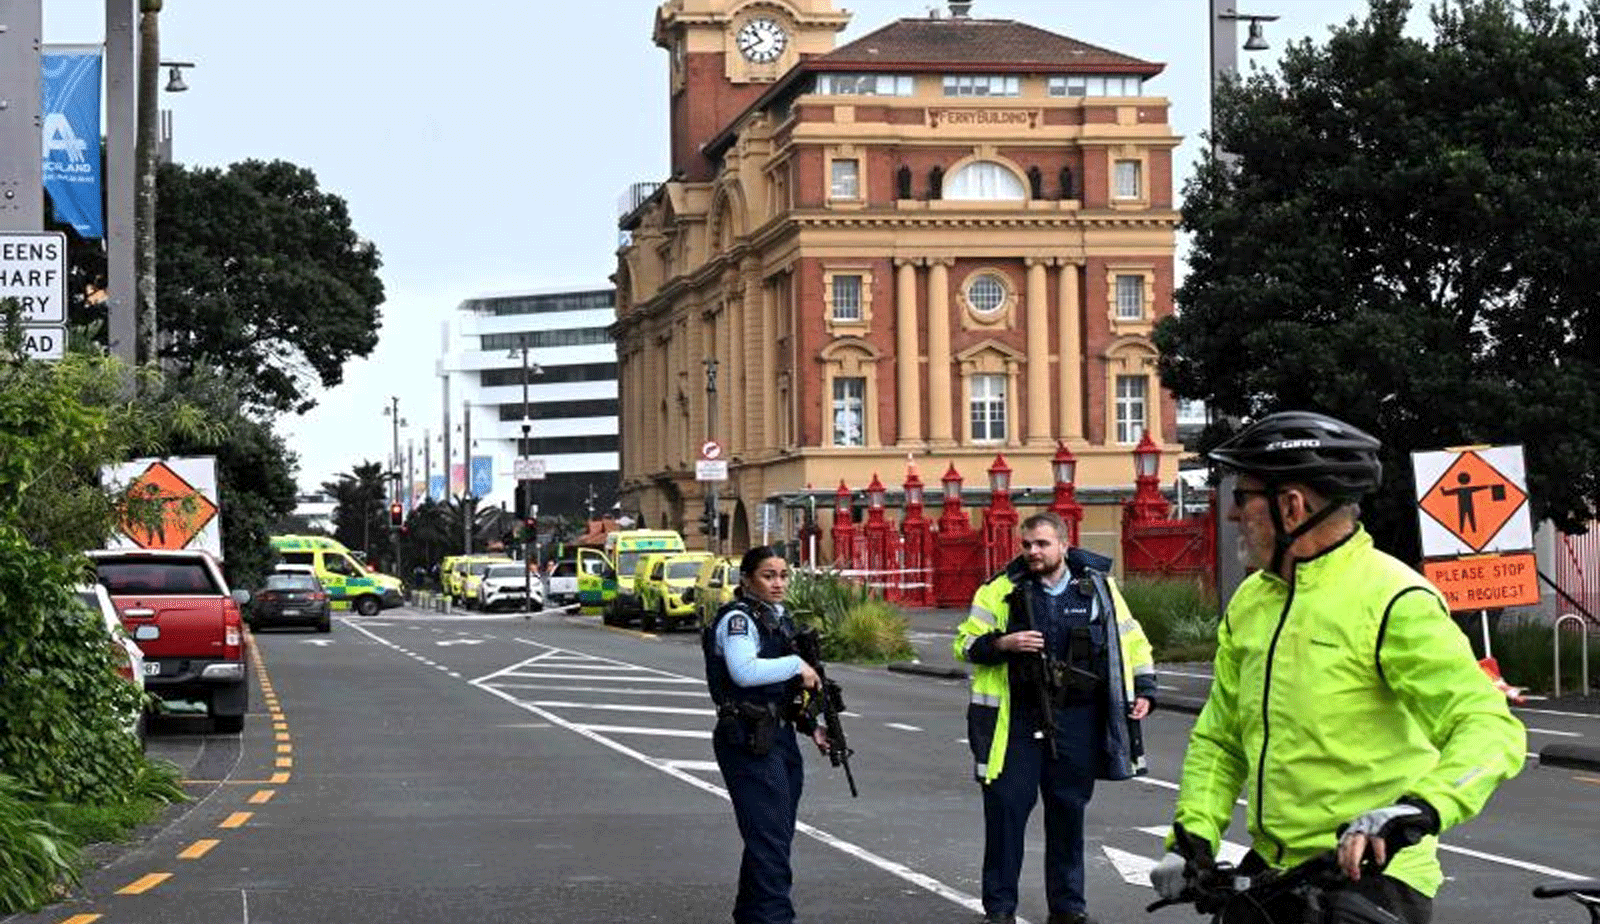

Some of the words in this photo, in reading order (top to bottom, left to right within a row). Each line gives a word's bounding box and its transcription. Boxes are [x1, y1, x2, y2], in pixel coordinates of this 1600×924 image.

[938, 109, 975, 124] FERRY
[977, 110, 1028, 124] BUILDING
[21, 296, 49, 314] RY
[25, 335, 53, 353] AD
[1435, 566, 1485, 583] PLEASE
[1493, 562, 1525, 577] STOP
[1467, 584, 1524, 602] REQUEST
